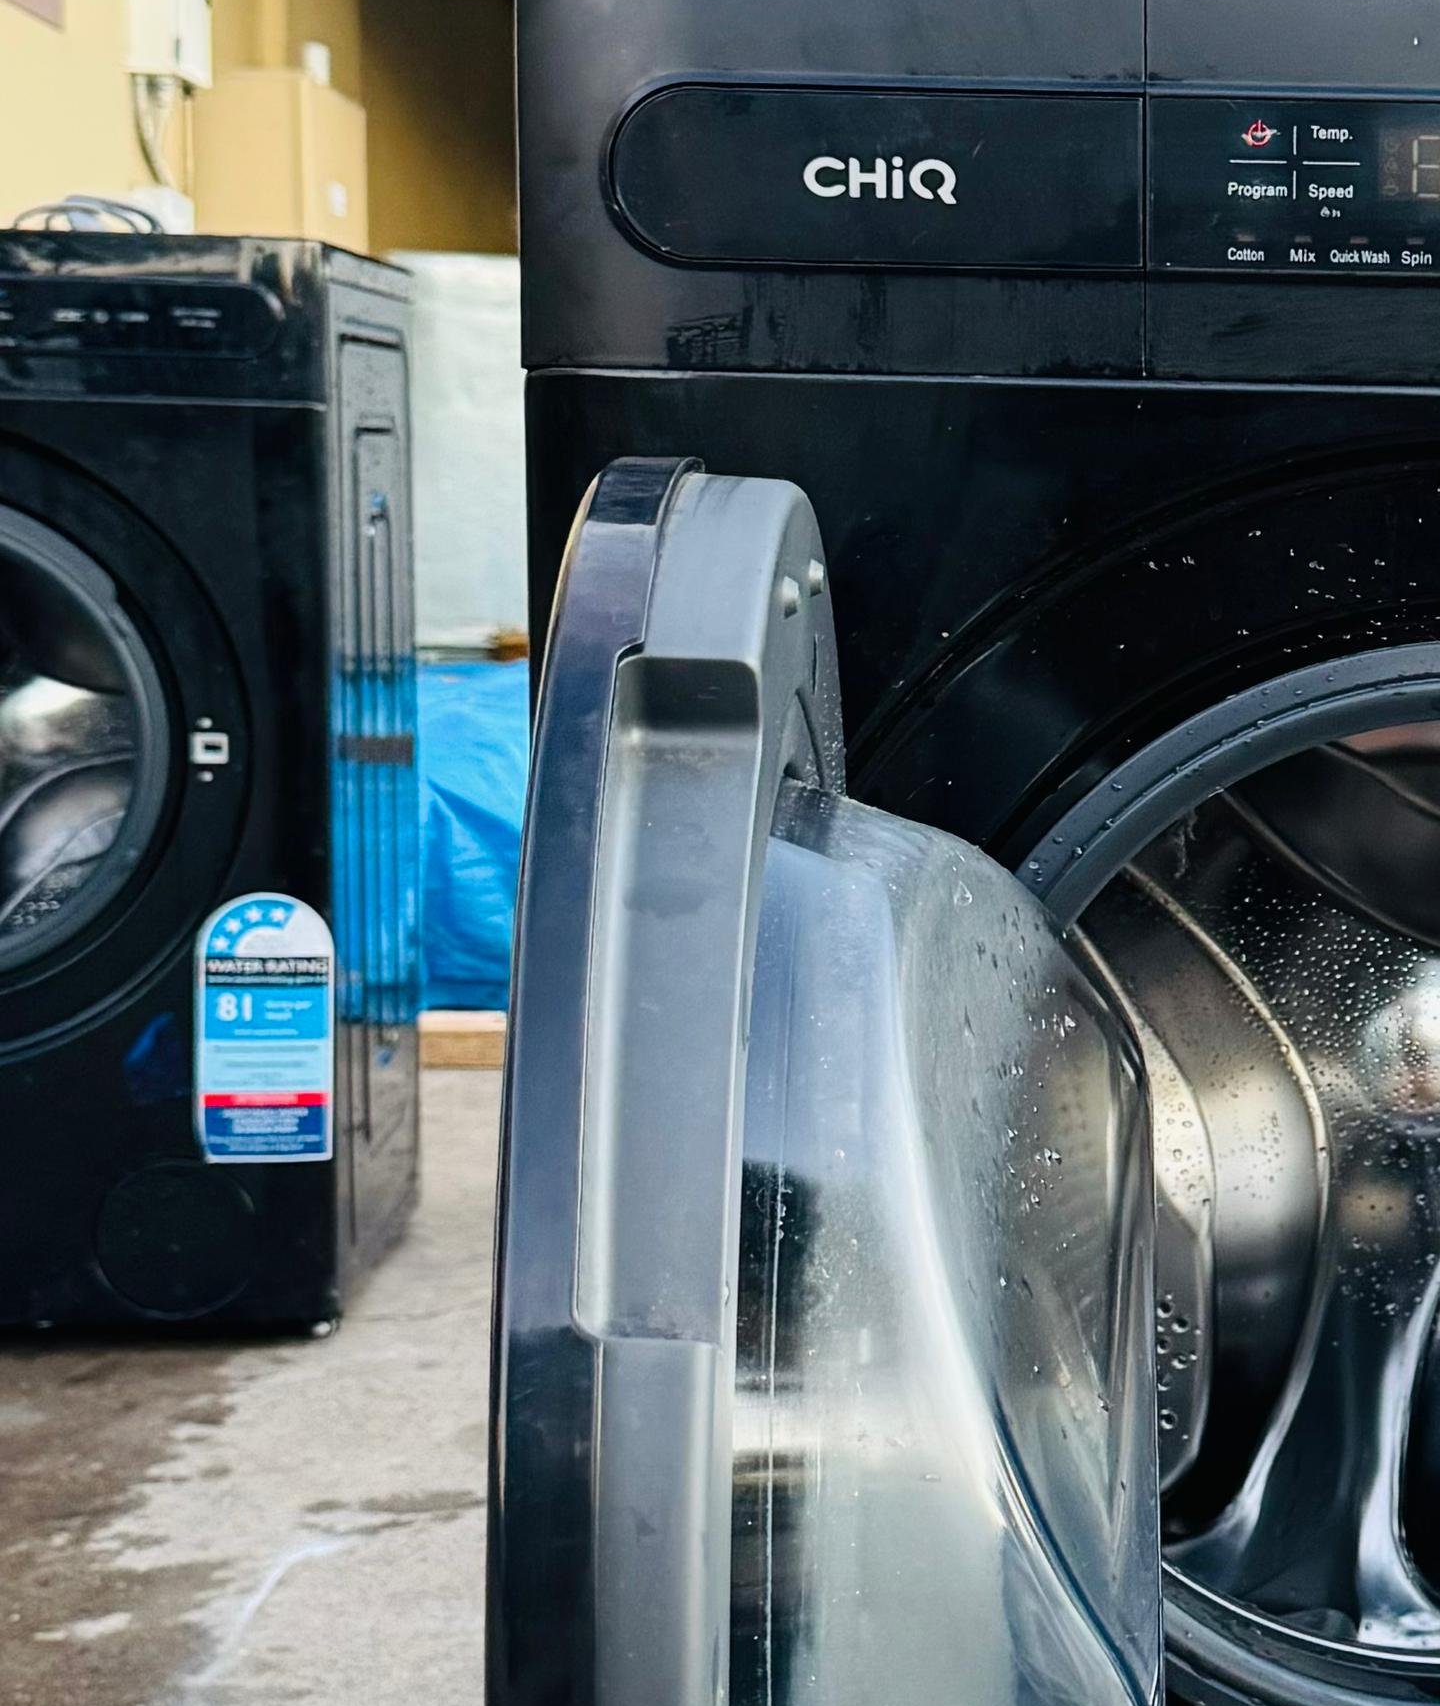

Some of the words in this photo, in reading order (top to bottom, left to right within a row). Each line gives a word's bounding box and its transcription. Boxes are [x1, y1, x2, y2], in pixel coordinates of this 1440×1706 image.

[1311, 126, 1353, 142] Temp.
[803, 156, 957, 205] CHiQ
[1228, 182, 1288, 198] Program
[1308, 184, 1354, 200] Speed
[1228, 247, 1265, 262] Cotton
[1289, 249, 1316, 263] Mix
[1330, 249, 1360, 264] Quick
[1361, 250, 1391, 264] Wash
[1401, 250, 1433, 267] Spin
